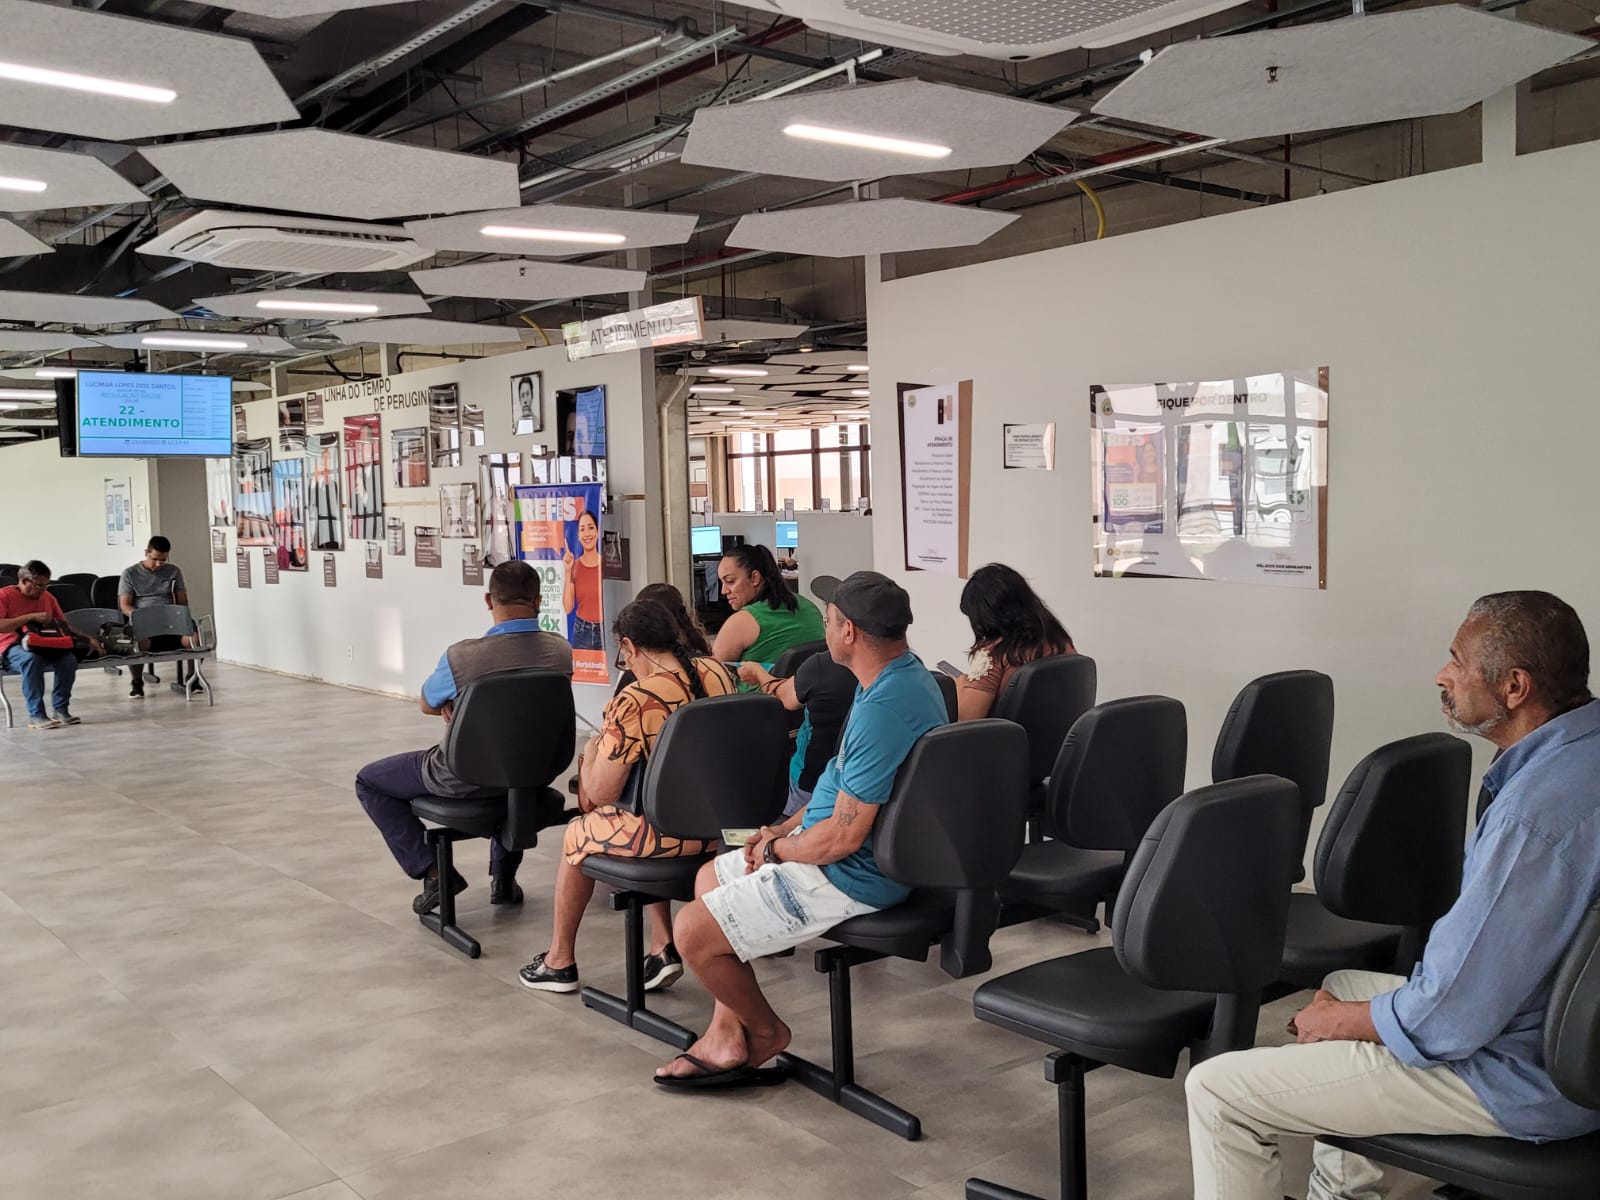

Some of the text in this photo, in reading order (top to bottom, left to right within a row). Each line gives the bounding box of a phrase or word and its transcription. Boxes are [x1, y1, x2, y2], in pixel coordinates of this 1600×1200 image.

[590, 317, 673, 346] ATENDIMENTO
[324, 378, 391, 402] LINHA DO TEMPO
[119, 405, 135, 415] 22
[373, 397, 385, 412] DE
[1157, 397, 1190, 411] FIQUE
[1218, 393, 1268, 406] DENTRO
[82, 417, 180, 428] ATENDIMENTO
[521, 497, 577, 522] REFIS
